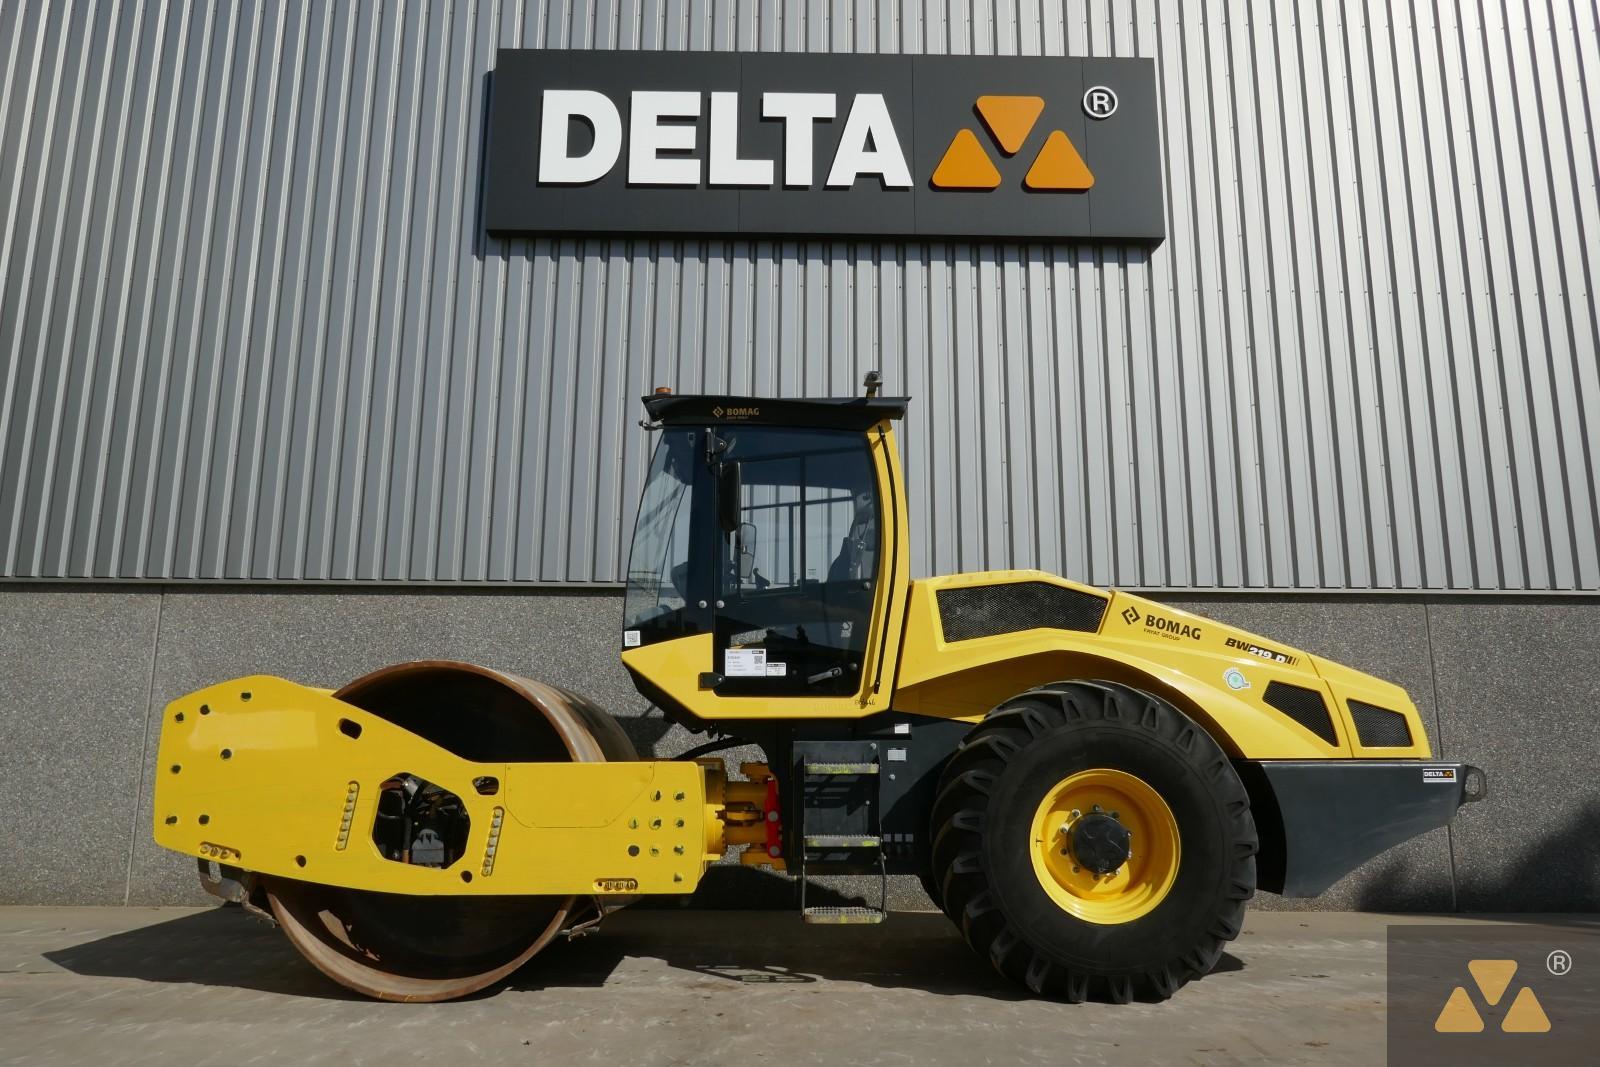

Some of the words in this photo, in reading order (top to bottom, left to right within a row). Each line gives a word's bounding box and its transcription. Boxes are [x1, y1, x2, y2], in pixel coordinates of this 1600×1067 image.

[538, 89, 914, 187] DELTA
[726, 407, 760, 416] BOMAG
[1145, 614, 1202, 640] BOMAG
